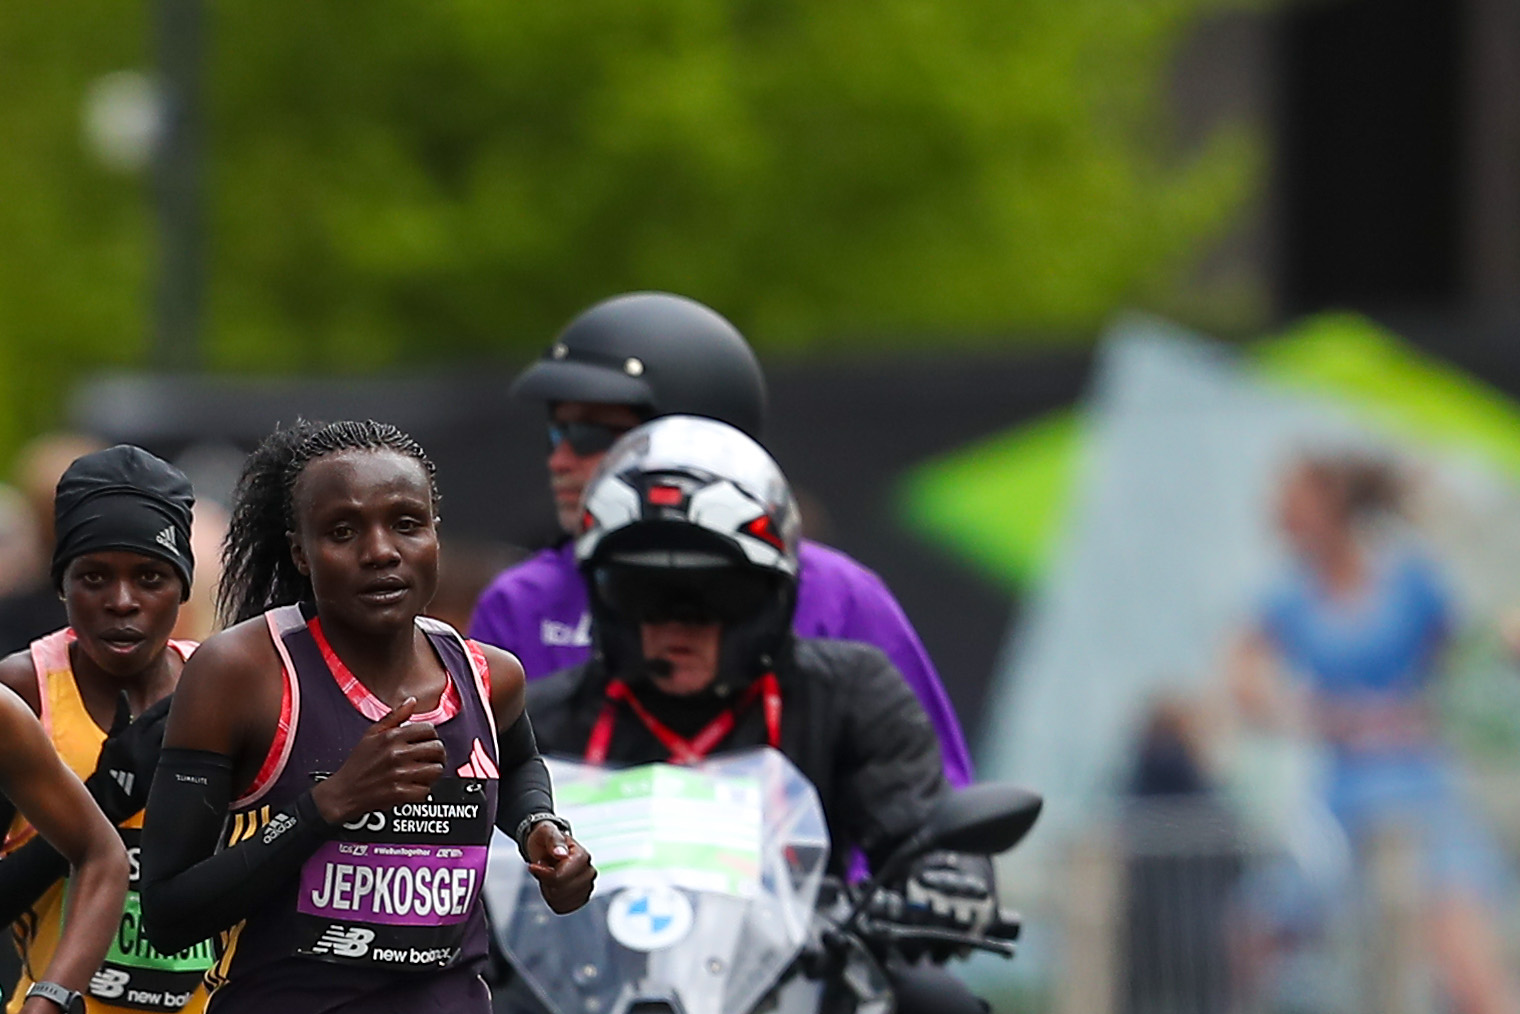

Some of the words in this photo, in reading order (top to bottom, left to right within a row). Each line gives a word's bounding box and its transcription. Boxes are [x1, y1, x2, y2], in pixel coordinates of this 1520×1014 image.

[393, 803, 478, 819] CONSULTANCY
[263, 817, 297, 844] adidas
[393, 819, 450, 834] SERVICES
[312, 862, 476, 917] JEPKOSGEI
[373, 946, 406, 963] new
[128, 990, 162, 1004] new
